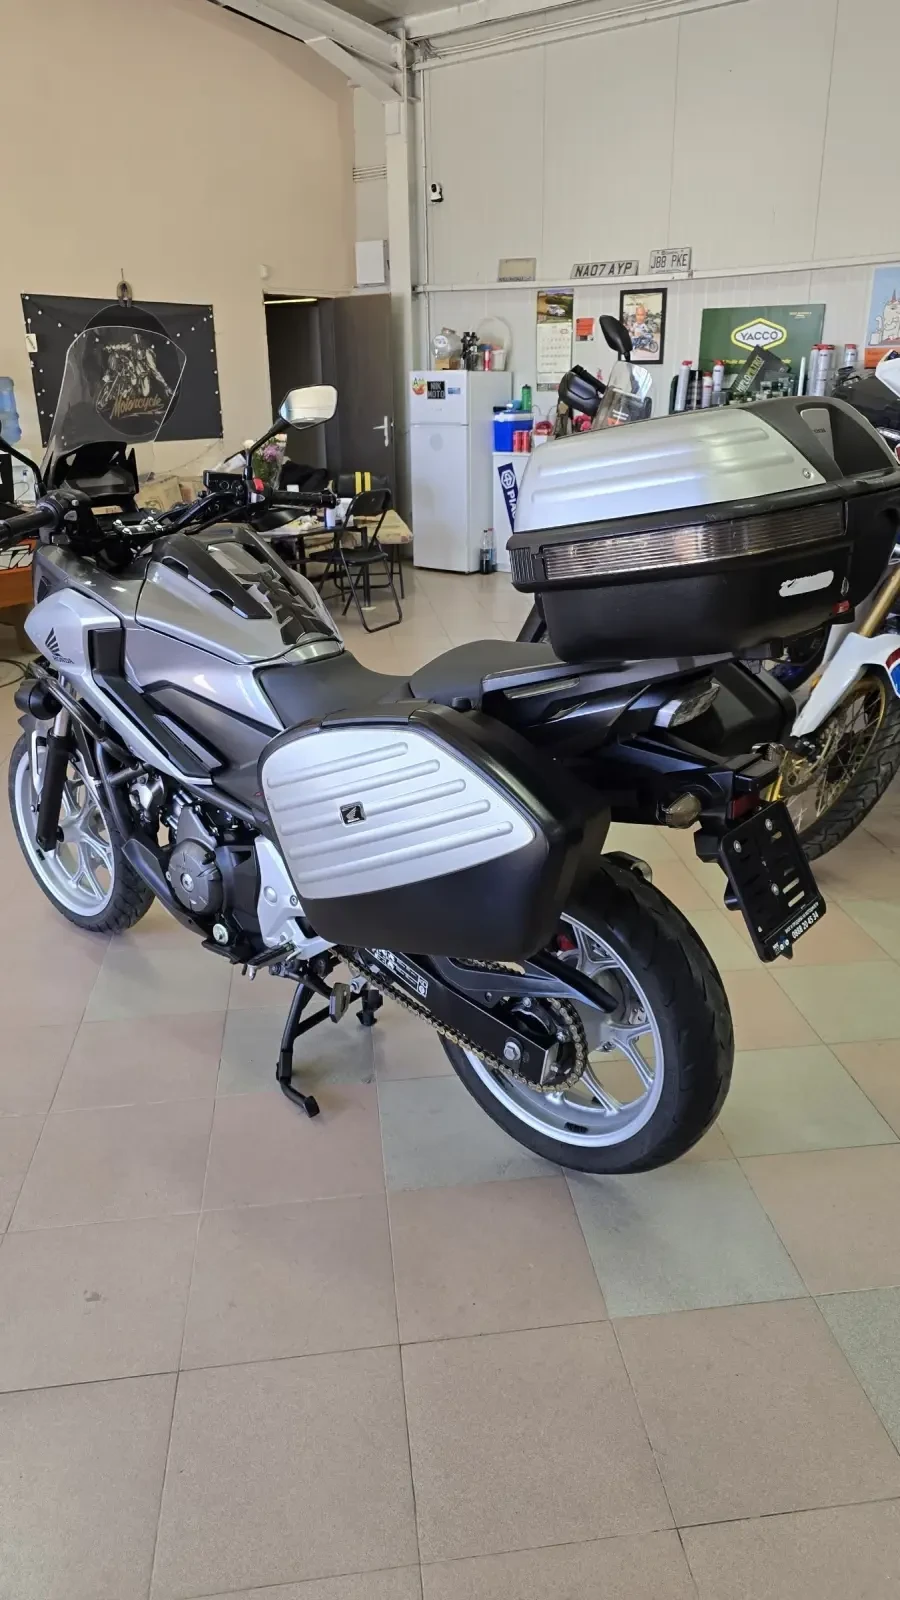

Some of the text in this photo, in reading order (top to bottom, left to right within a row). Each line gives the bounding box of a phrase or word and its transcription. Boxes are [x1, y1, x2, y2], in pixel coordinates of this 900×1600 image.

[651, 253, 688, 269] J88 PKE
[608, 262, 633, 276] AYP
[740, 331, 778, 341] YACCO
[430, 382, 442, 390] NIK
[427, 390, 446, 398] MOTO
[110, 392, 164, 420] Motorcycle
[802, 920, 808, 929] 20
